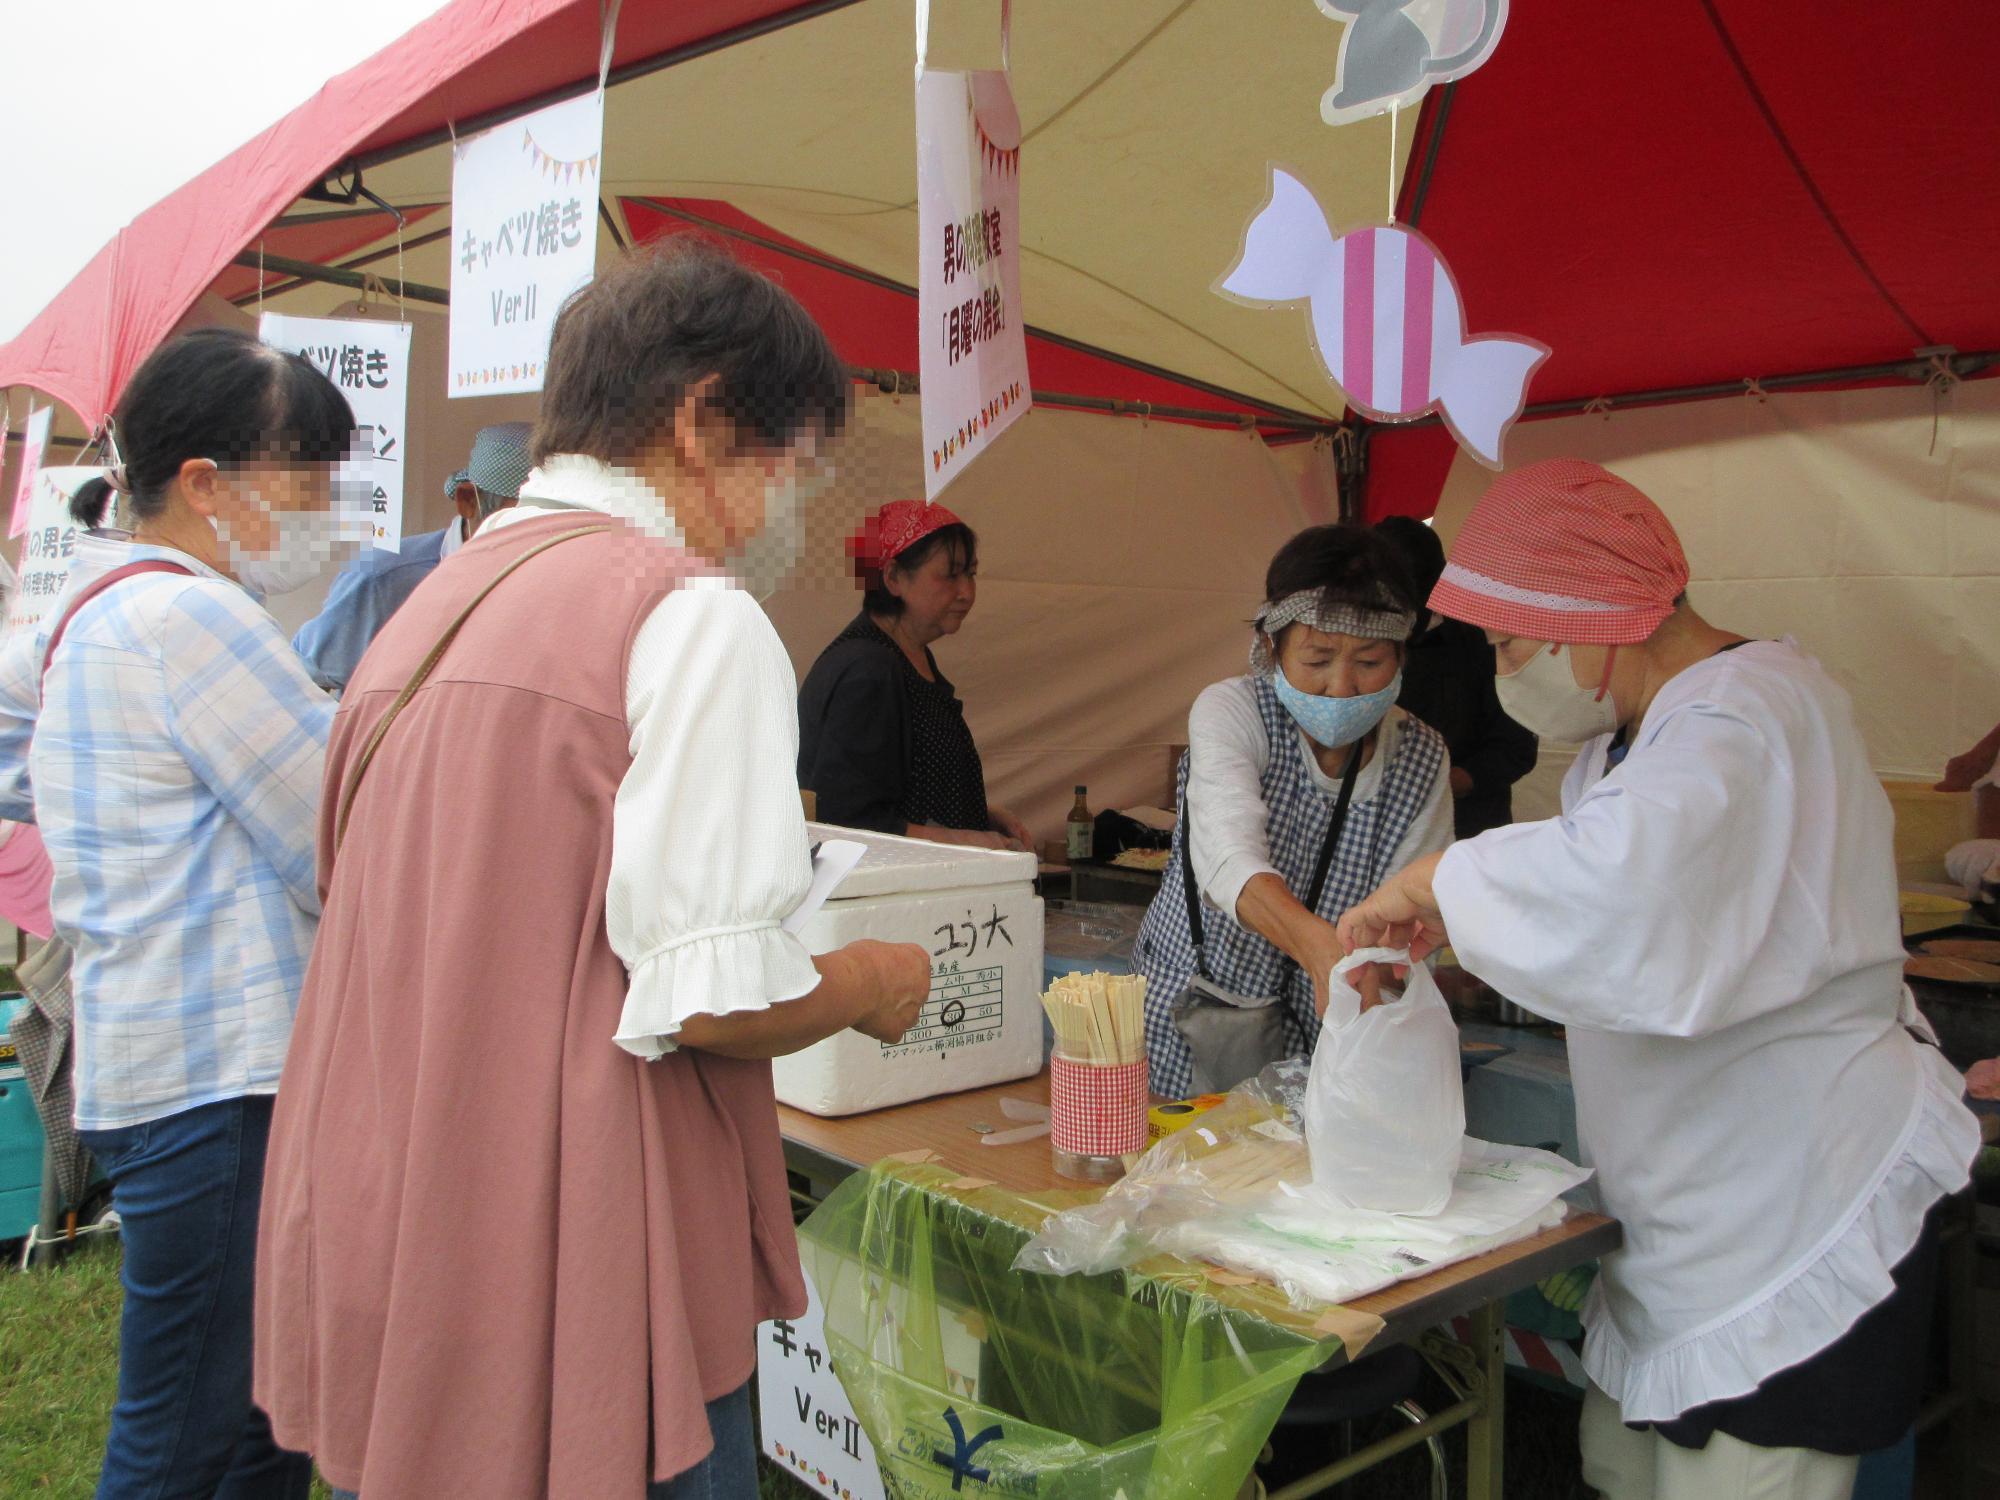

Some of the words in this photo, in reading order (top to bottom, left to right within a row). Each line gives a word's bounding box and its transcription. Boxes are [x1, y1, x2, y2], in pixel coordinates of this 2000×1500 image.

[461, 197, 583, 274] キャベツ焼き
[944, 206, 1002, 285] 男の料理教室
[772, 1320, 835, 1374] キャ
